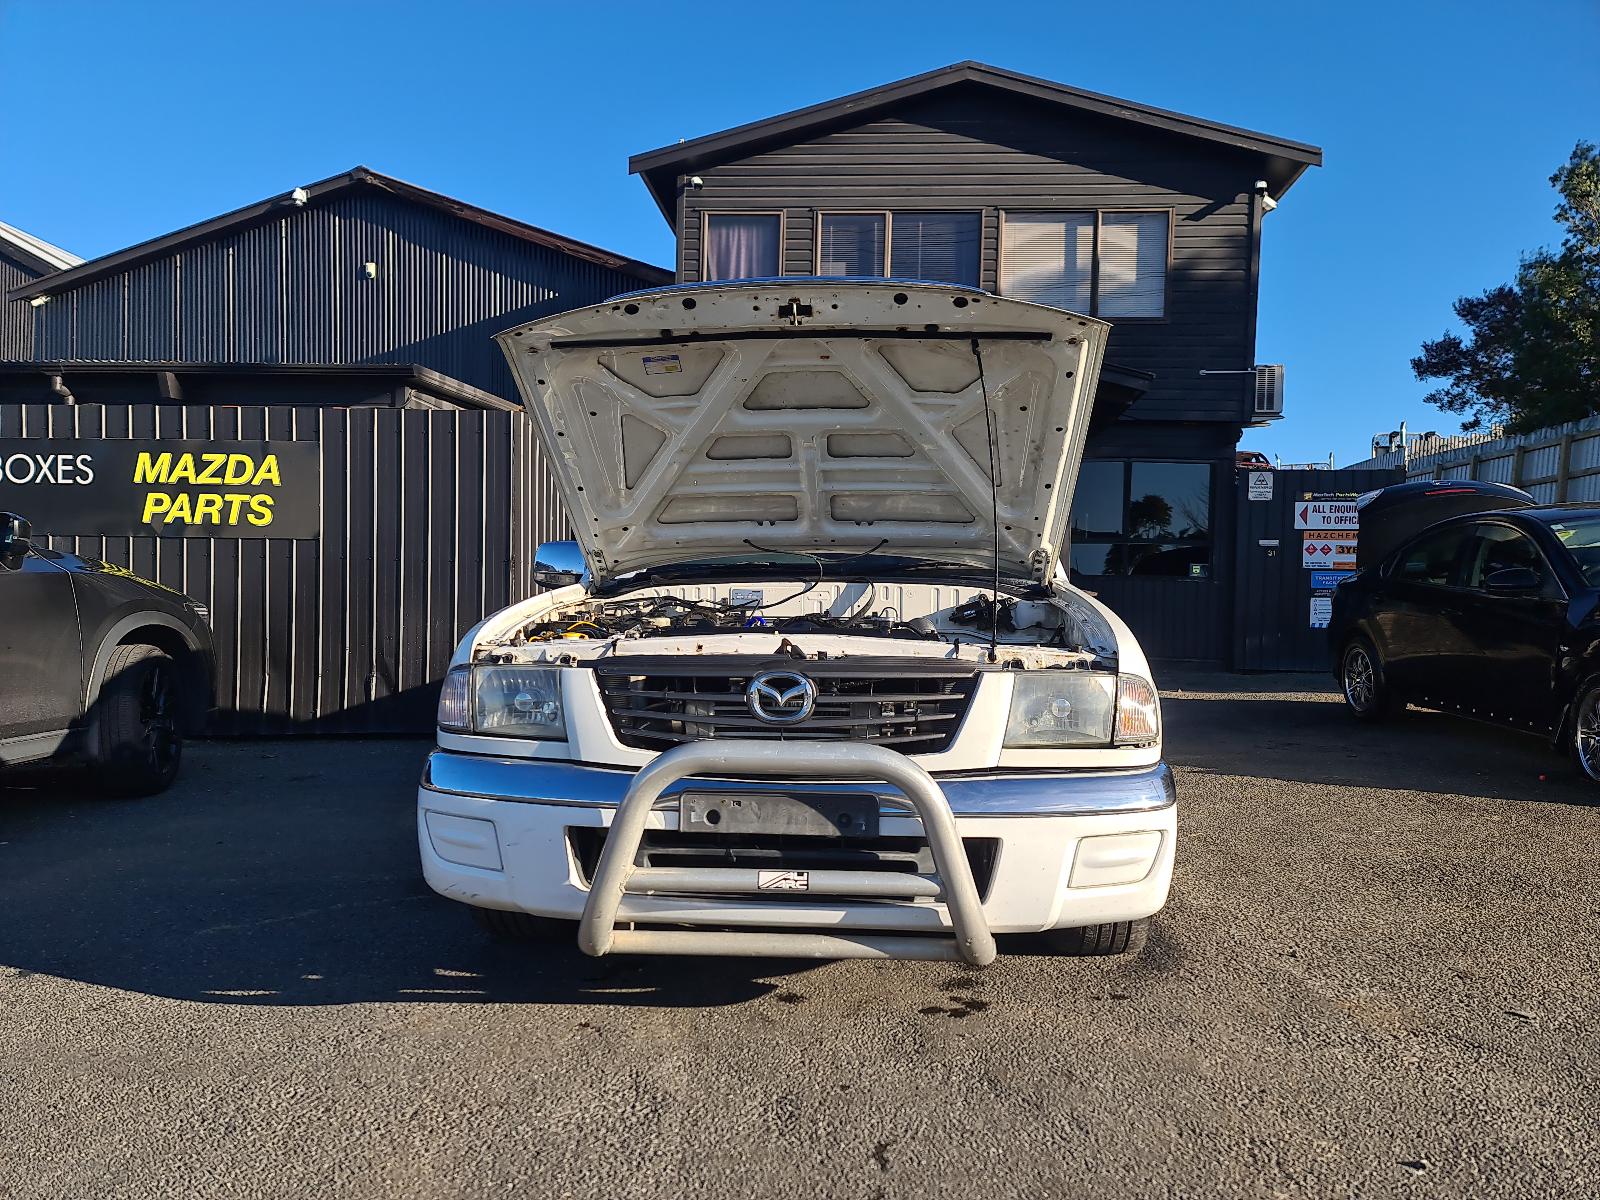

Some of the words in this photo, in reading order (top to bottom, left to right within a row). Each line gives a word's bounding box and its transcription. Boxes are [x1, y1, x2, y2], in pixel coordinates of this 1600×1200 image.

[0, 453, 94, 485] OXES
[133, 452, 281, 487] MAZDA
[142, 492, 274, 526] PARTS
[1311, 504, 1327, 514] ALL
[1321, 516, 1332, 525] TO
